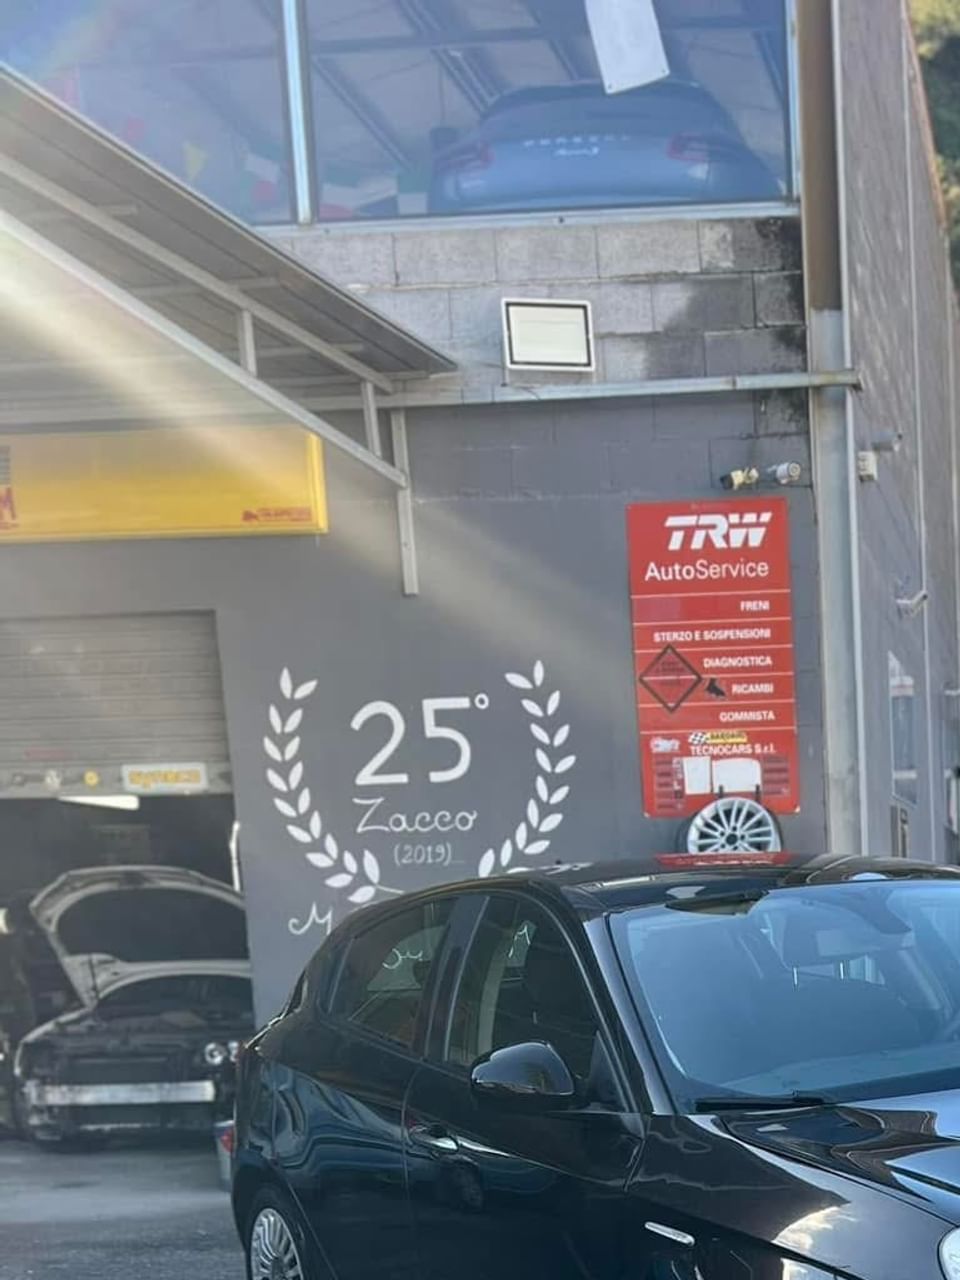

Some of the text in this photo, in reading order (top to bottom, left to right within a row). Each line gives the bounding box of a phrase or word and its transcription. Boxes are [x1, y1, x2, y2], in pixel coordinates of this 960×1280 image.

[664, 512, 772, 550] TRW
[645, 558, 769, 581] AutoService
[740, 600, 770, 611] FRENI
[653, 628, 771, 643] STERZO E SOSPENSIONI
[704, 656, 773, 668] DIAGNOSTICA
[732, 683, 774, 694] RICAMBI
[719, 711, 775, 722] GOMMISTA
[690, 744, 752, 756] TECNOCARS
[352, 797, 478, 833] Zacco
[394, 842, 452, 867] (2019)
